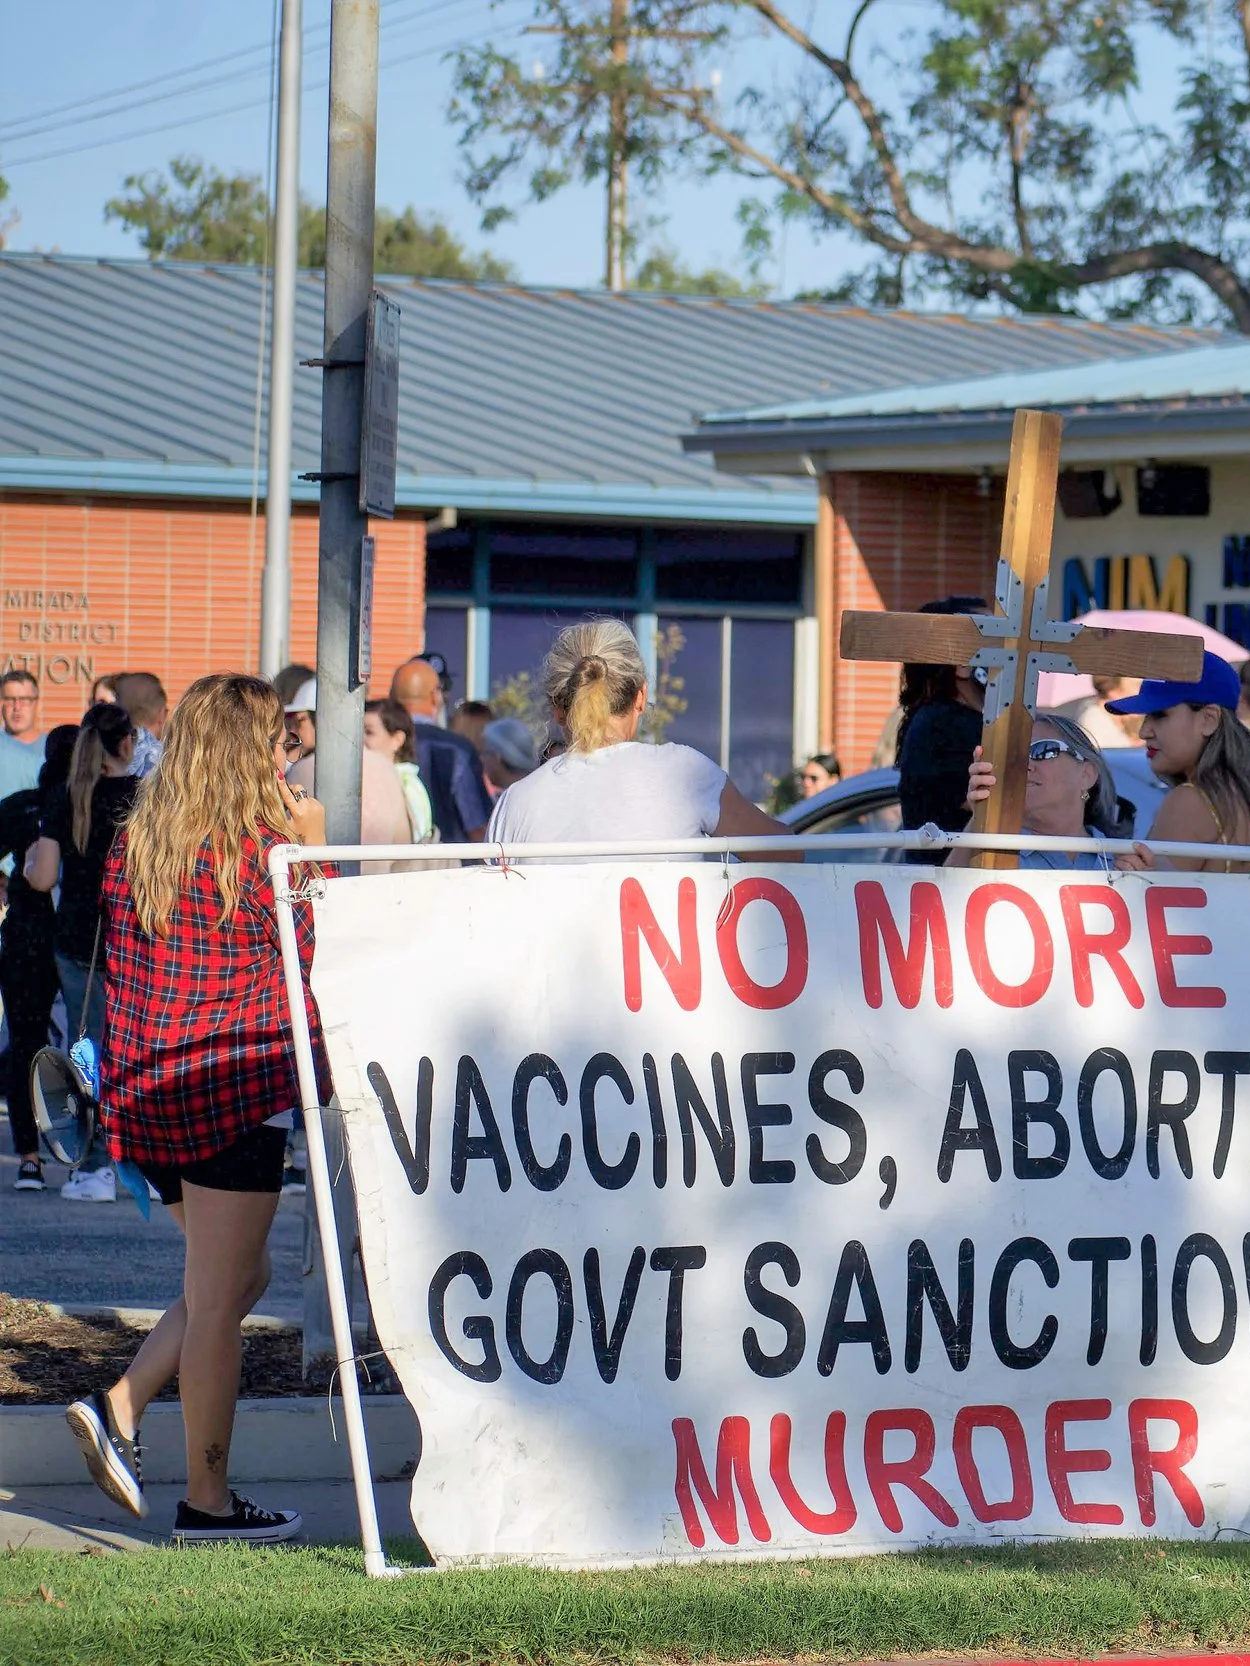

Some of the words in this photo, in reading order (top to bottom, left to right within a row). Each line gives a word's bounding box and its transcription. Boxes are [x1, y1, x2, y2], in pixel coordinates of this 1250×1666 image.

[5, 589, 90, 611] MIRADA
[19, 621, 119, 644] DISTRICT
[619, 876, 809, 1013] NO
[856, 880, 1227, 1010] MORE
[367, 1050, 897, 1210] VACCINES,
[428, 1244, 707, 1386] GOVT
[672, 1398, 1206, 1549] MURDER
